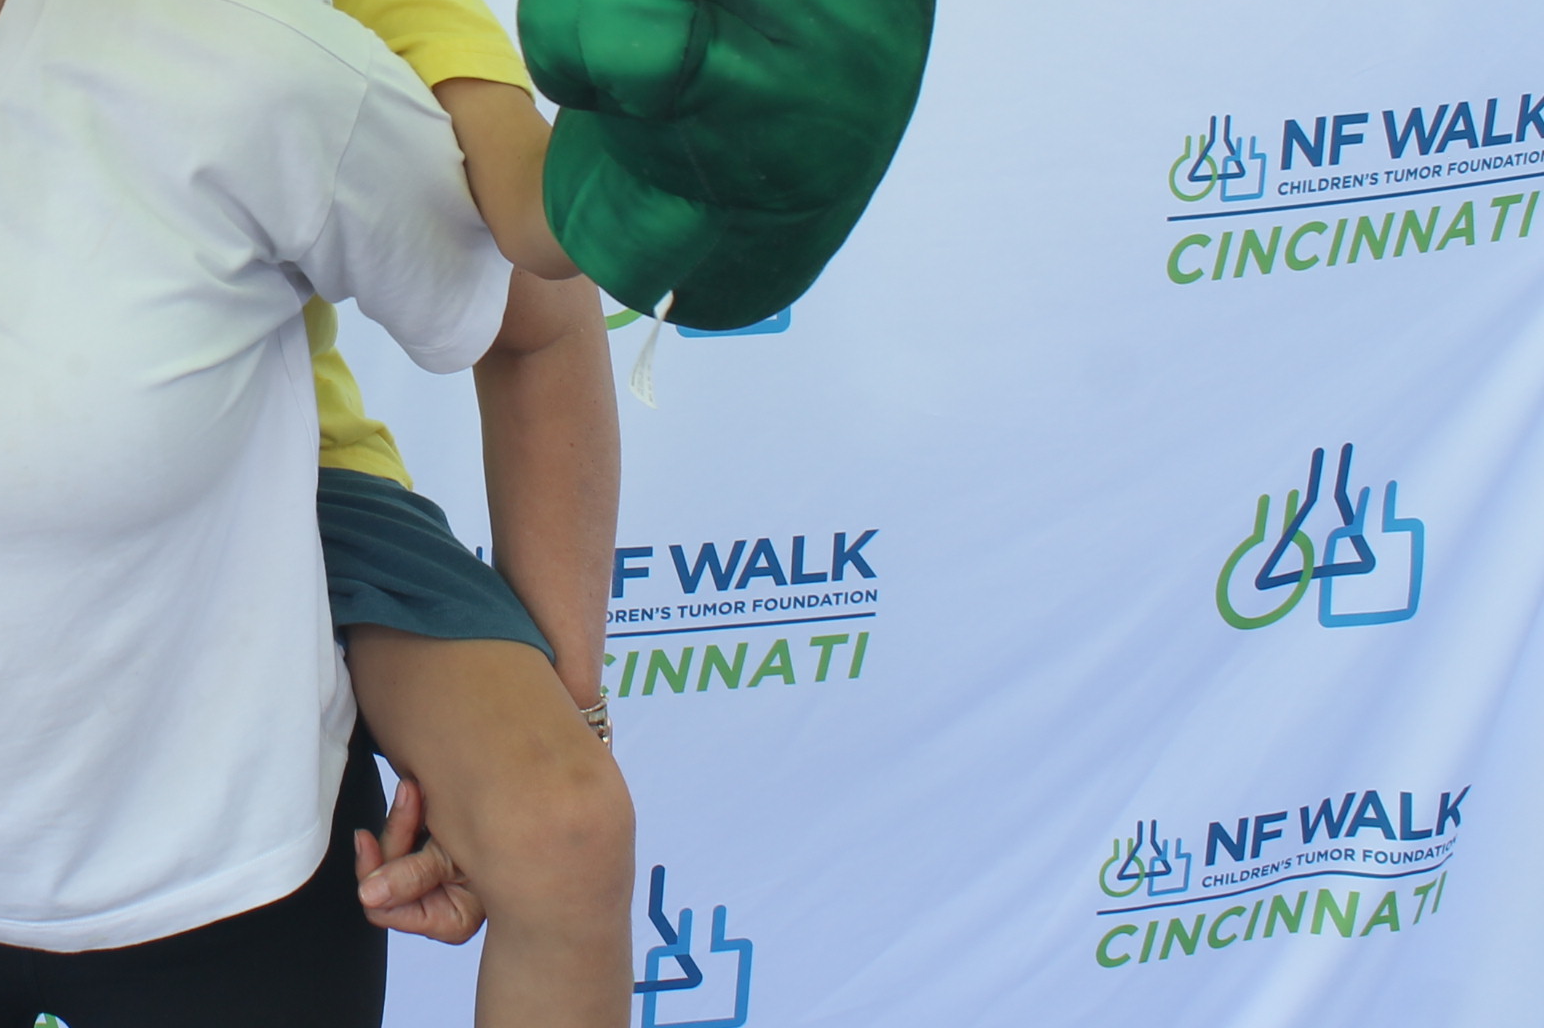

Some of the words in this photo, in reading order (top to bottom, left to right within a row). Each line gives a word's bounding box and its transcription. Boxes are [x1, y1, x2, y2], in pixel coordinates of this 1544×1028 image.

[1280, 112, 1370, 171] NF
[1382, 93, 1544, 160] WALK
[1277, 172, 1379, 197] CHILDREN'S
[1384, 165, 1443, 185] TUMOR
[1167, 190, 1541, 285] CINCINNATI
[611, 545, 654, 599] F
[668, 528, 880, 594] WALK
[677, 600, 746, 619] TUMOR
[752, 588, 878, 613] FOUNDATION
[1204, 810, 1288, 867] NF
[1299, 784, 1472, 845] WALK
[1201, 857, 1292, 888] CHILDREN'S
[1296, 847, 1356, 866] TUMOR
[1095, 869, 1448, 969] CINCINNATI
